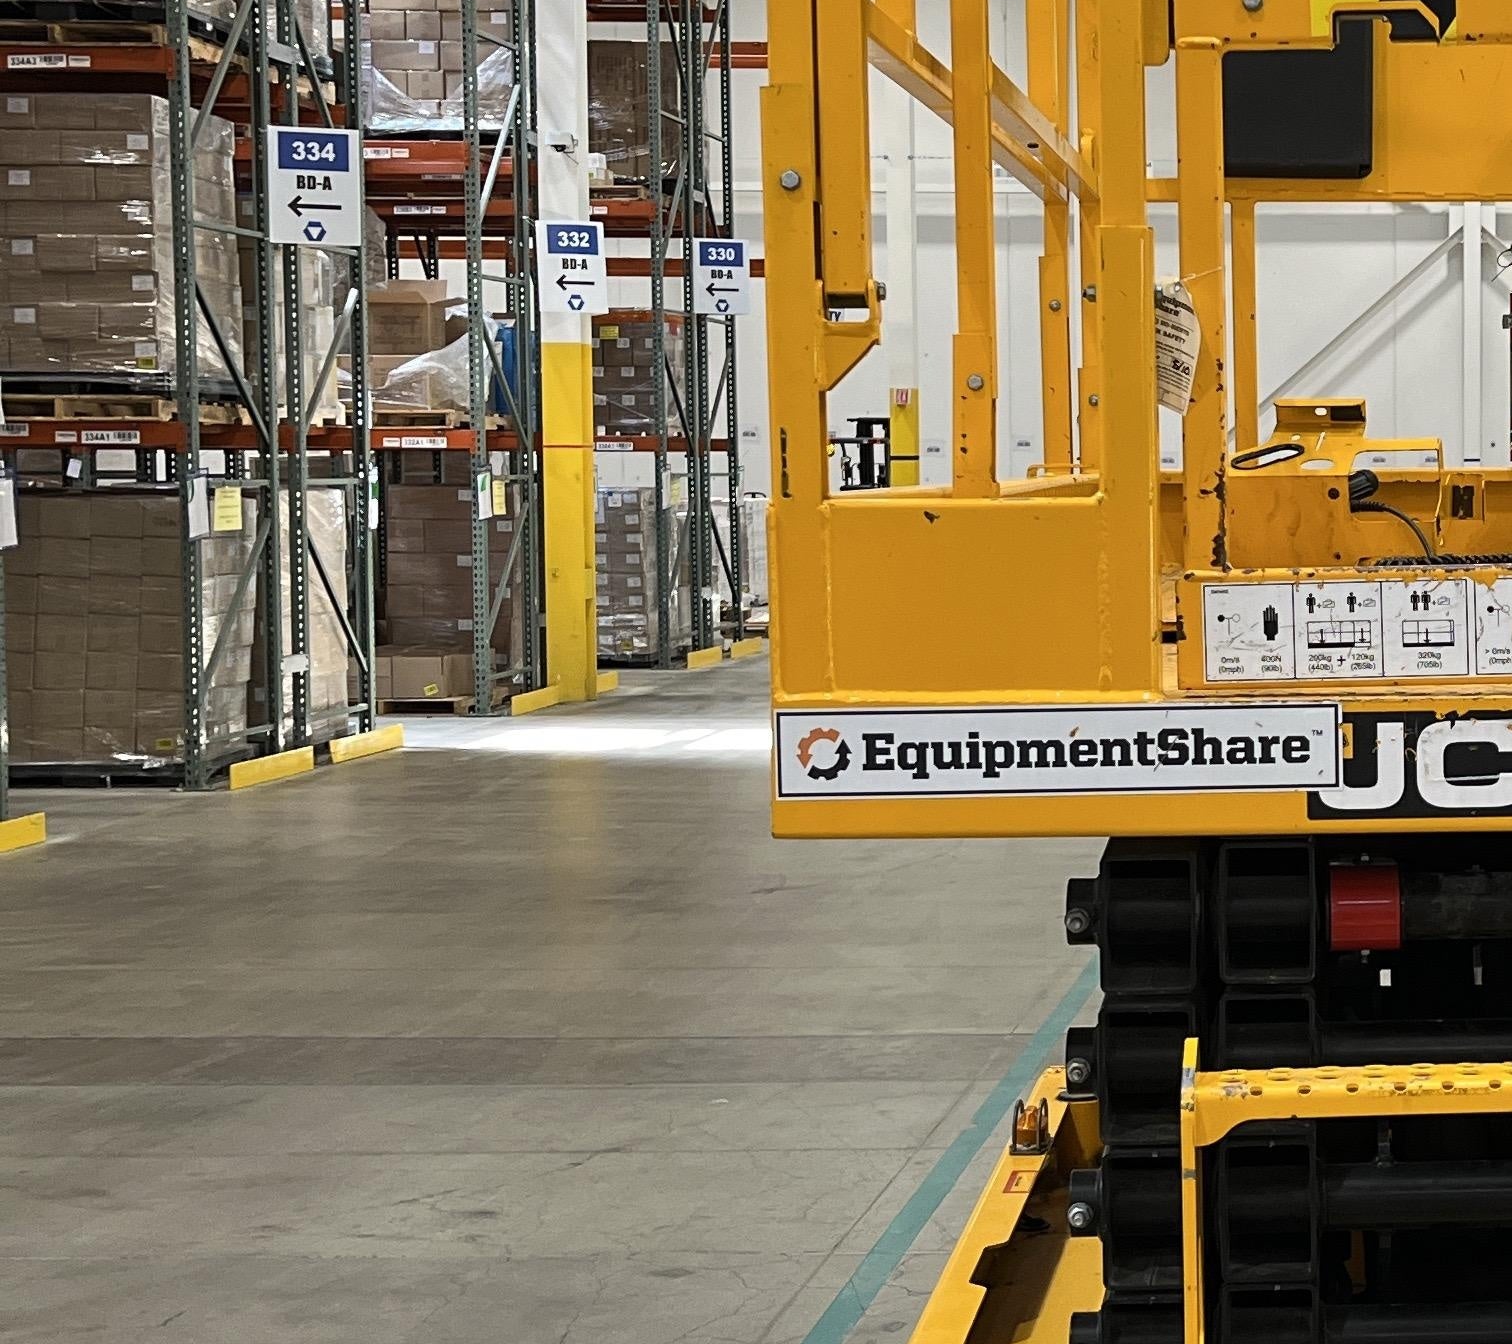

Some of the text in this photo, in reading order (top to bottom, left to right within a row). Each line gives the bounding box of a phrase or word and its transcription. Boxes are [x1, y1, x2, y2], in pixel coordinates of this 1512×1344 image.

[291, 141, 336, 162] 334
[296, 175, 332, 190] BD-A
[557, 231, 590, 248] 332
[707, 247, 735, 261] 330
[562, 258, 588, 270] BD-A
[710, 269, 733, 280] BD-A
[1352, 653, 1375, 662] 120kg
[861, 727, 1310, 780] EquipmentShare
